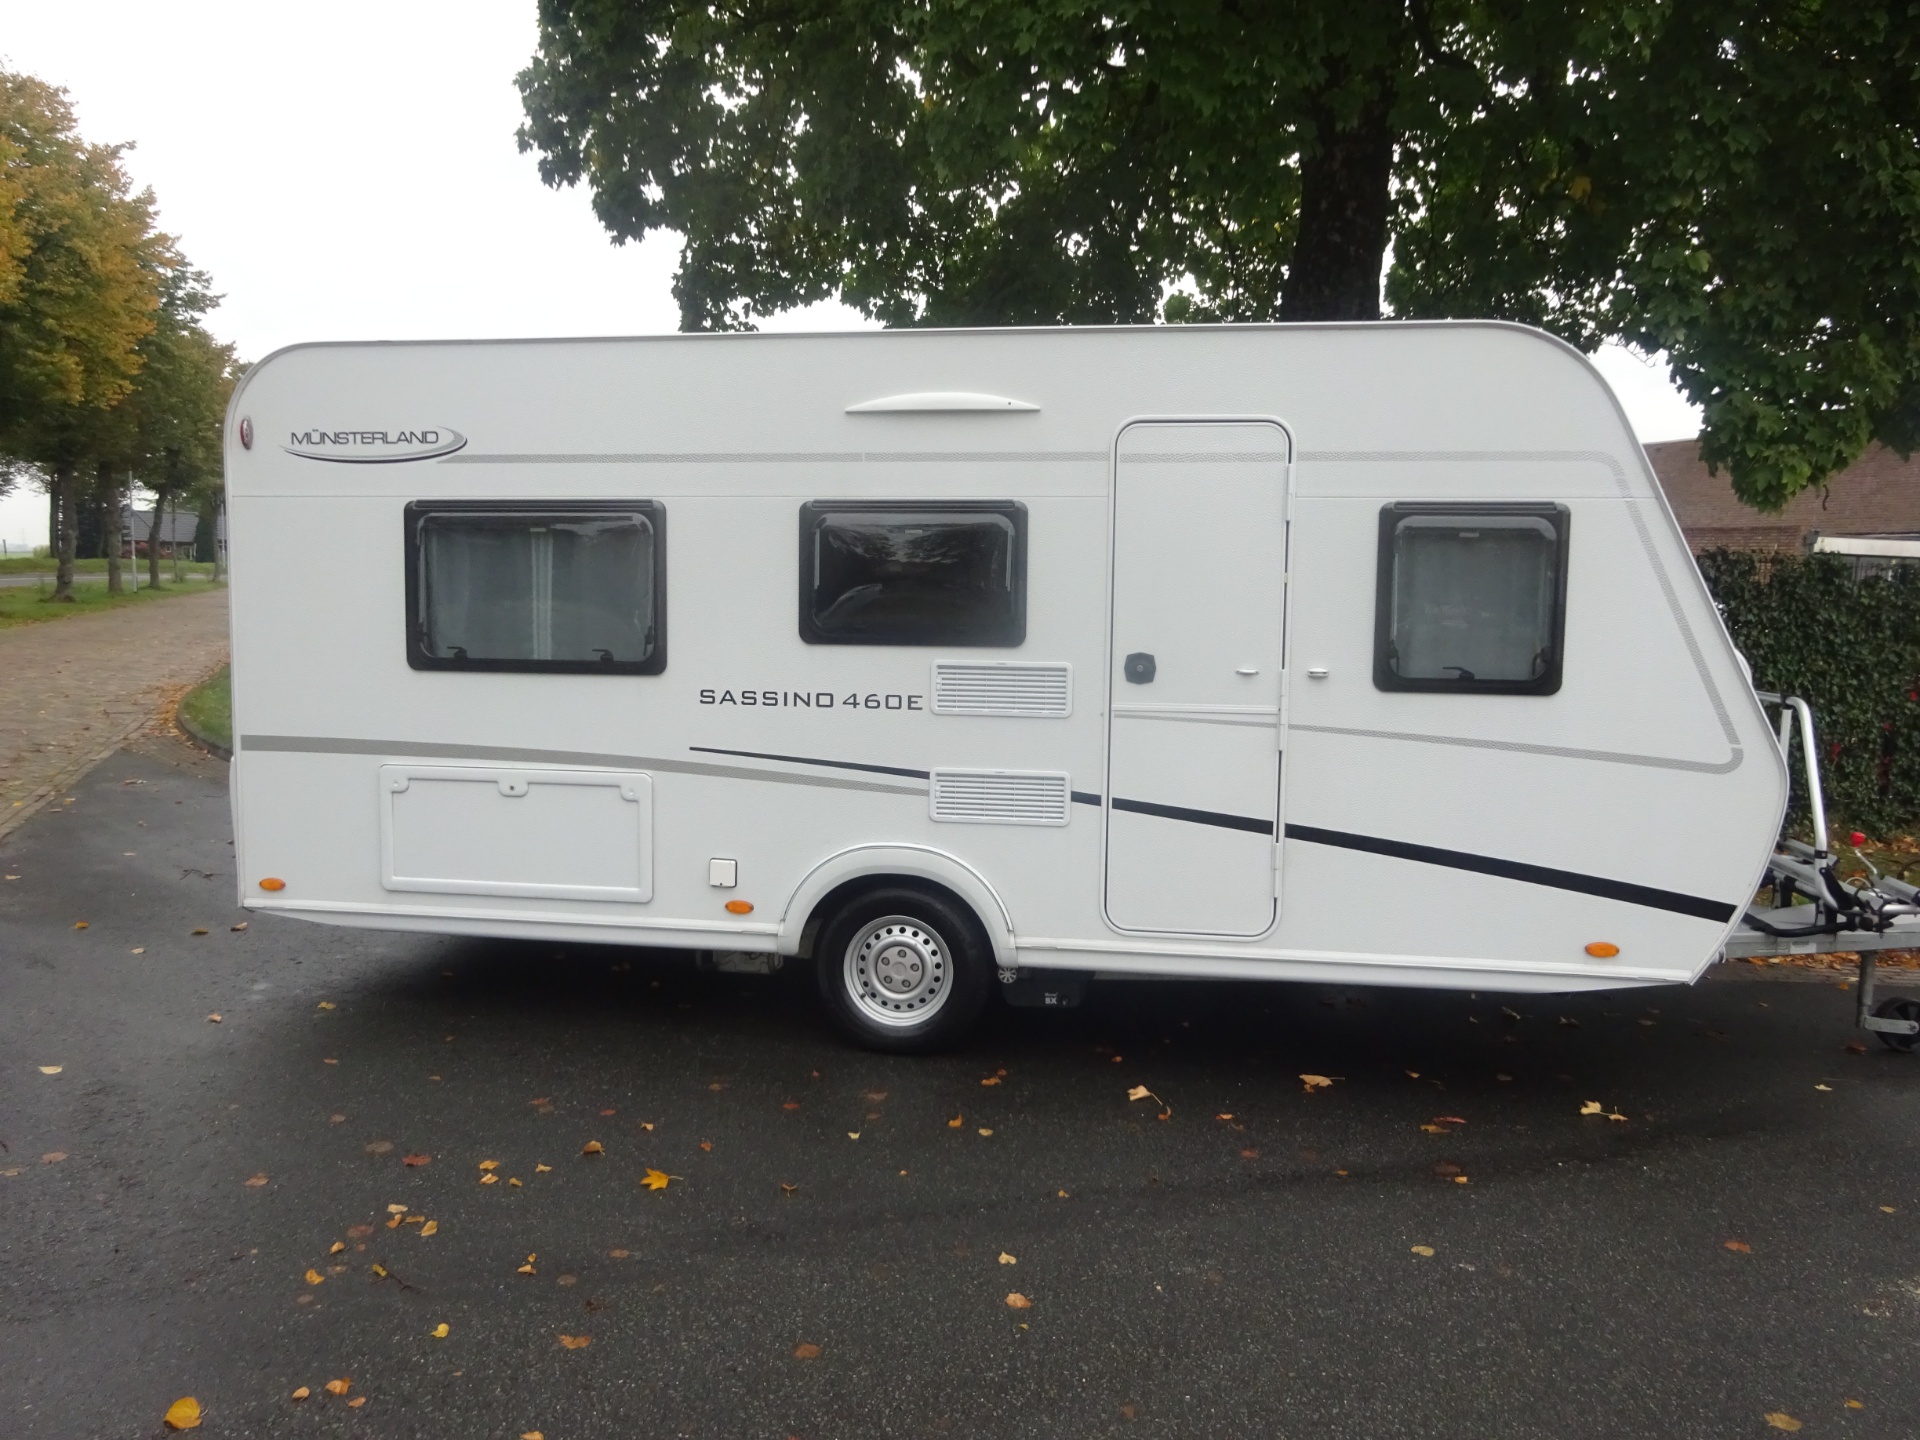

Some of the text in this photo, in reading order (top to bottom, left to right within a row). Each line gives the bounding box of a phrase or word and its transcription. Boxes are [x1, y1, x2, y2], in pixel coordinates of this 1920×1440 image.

[291, 429, 439, 445] MÜNSTERLAND
[699, 689, 924, 711] SASSINO 460E
